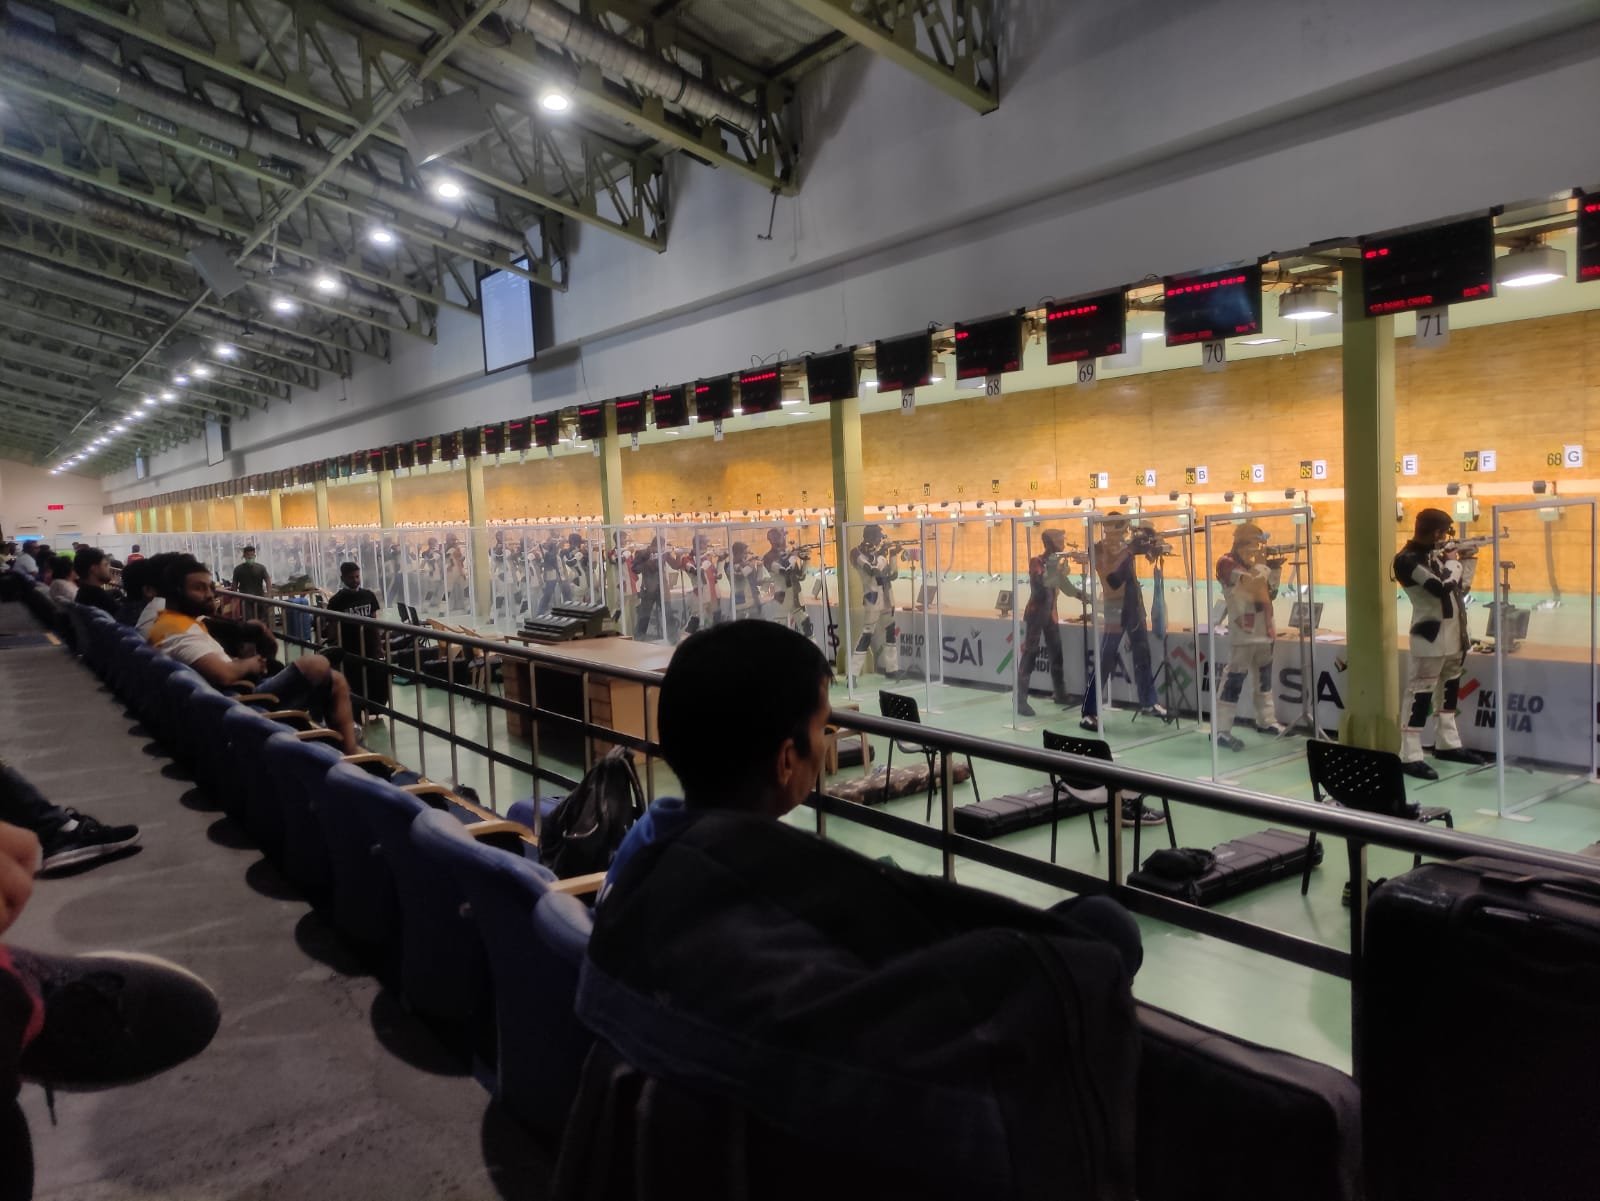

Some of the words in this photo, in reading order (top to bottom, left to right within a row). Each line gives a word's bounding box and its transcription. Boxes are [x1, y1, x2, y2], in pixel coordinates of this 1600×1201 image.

[1419, 313, 1443, 337] 71
[1204, 344, 1223, 363] 70
[1079, 363, 1094, 383] 69
[986, 378, 1000, 397] 68
[902, 393, 913, 409] 67
[1482, 455, 1491, 467] F
[1547, 453, 1562, 466] 68
[1567, 450, 1580, 463] G
[1315, 464, 1324, 475] D
[1405, 459, 1414, 471] E
[1463, 457, 1478, 471] 67
[1147, 473, 1154, 483] A
[1198, 470, 1206, 480] B
[1240, 472, 1250, 481] 64
[1254, 468, 1262, 479] C
[1300, 465, 1312, 478] 65
[943, 636, 984, 667] SAI
